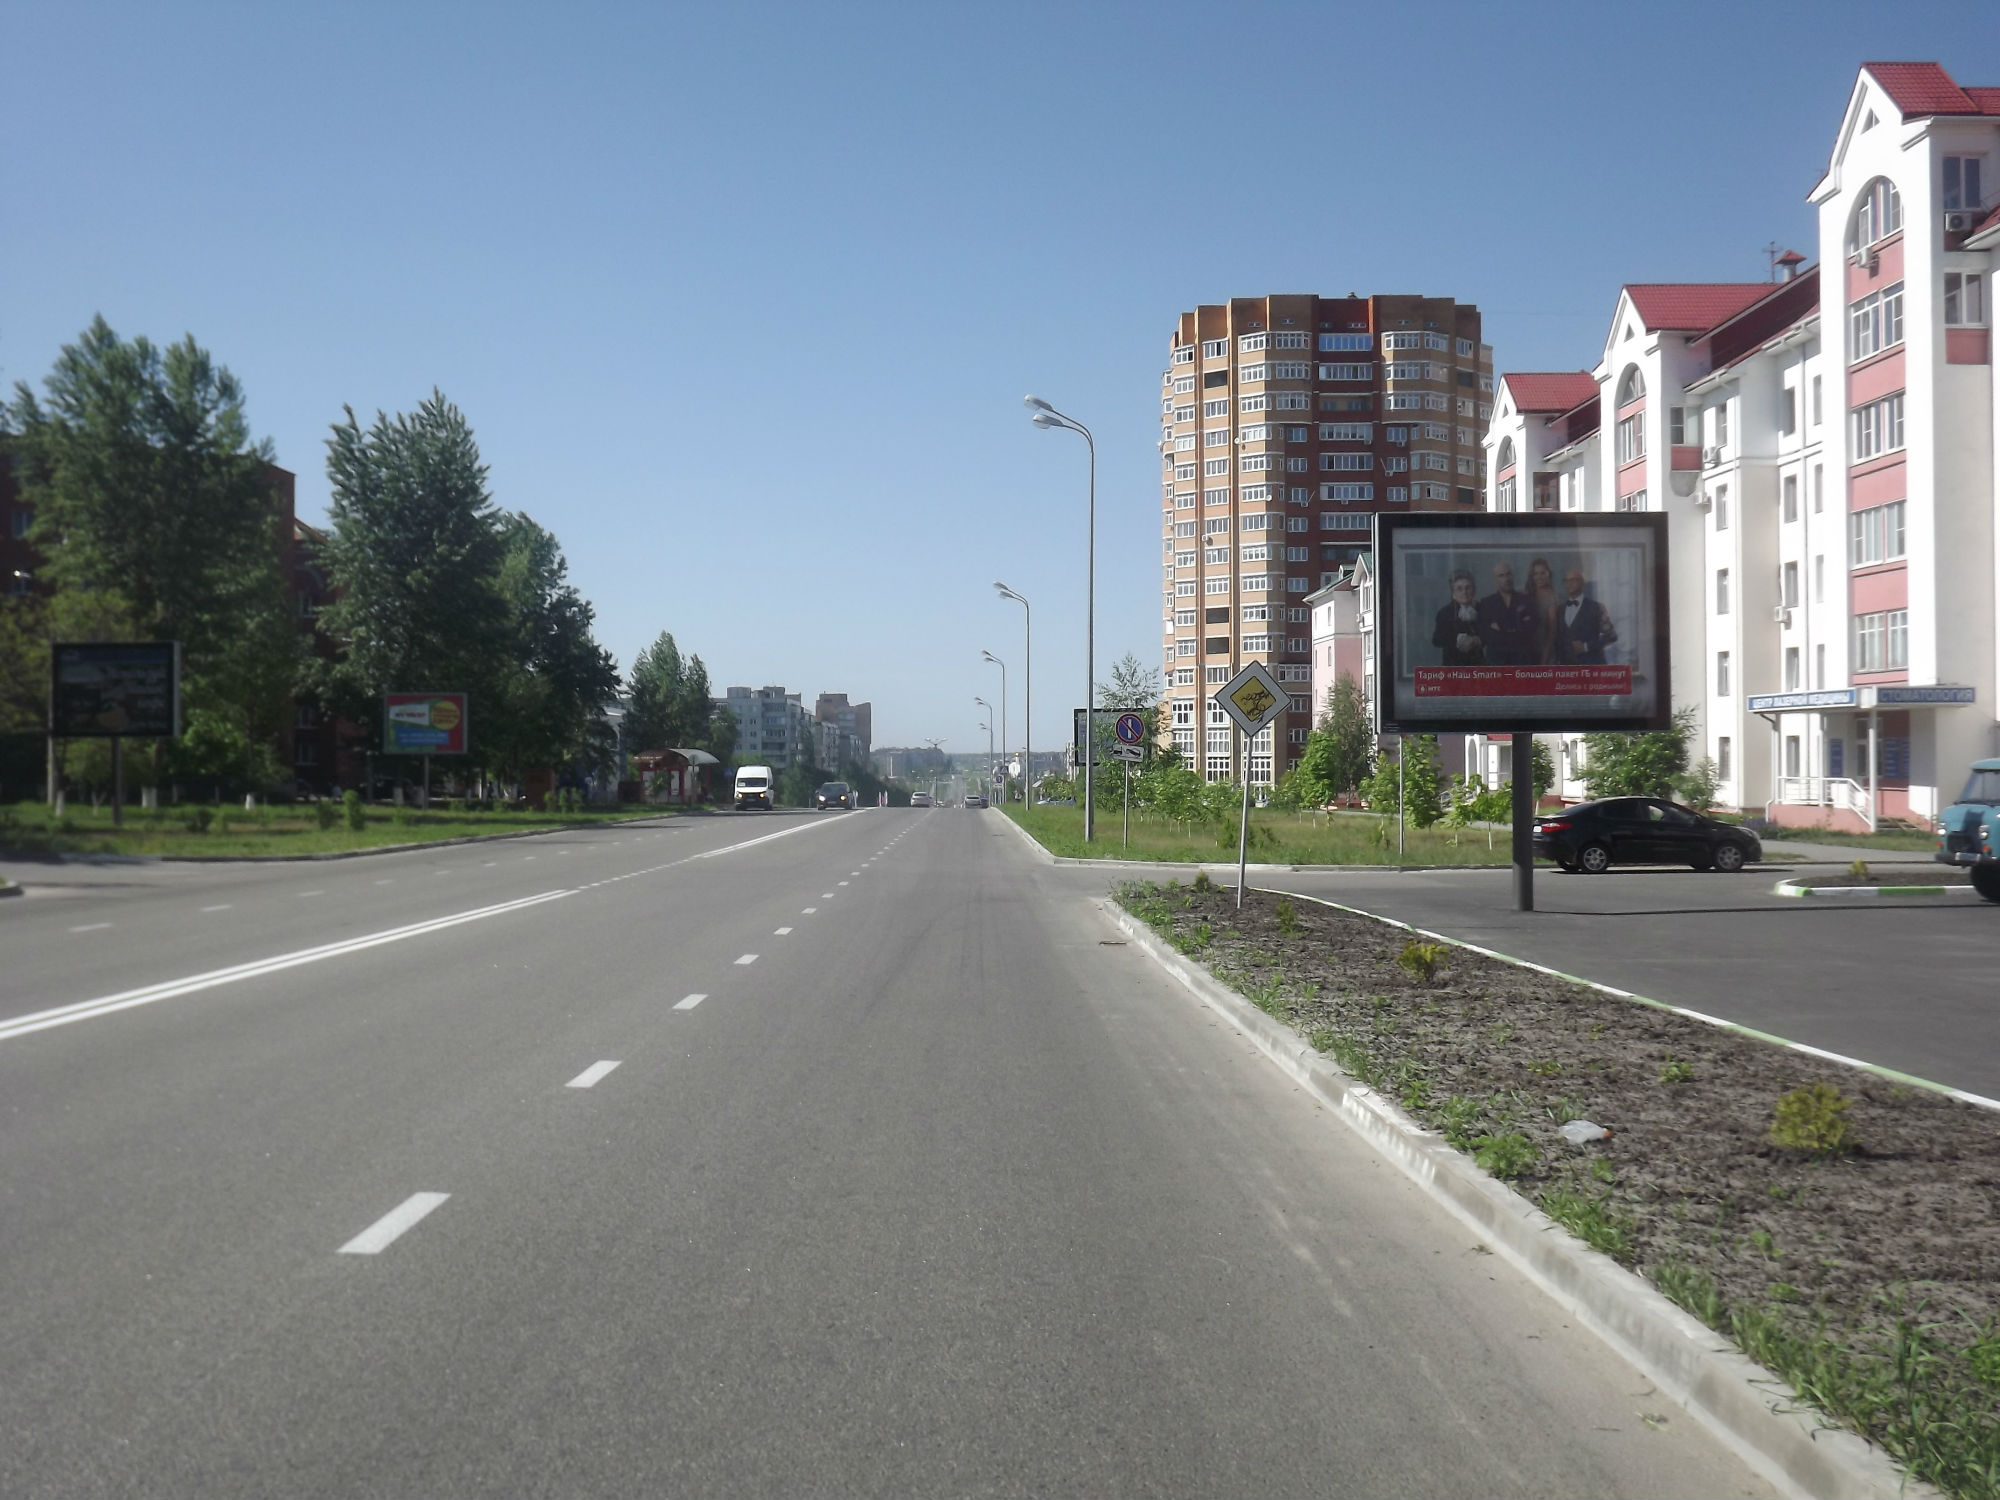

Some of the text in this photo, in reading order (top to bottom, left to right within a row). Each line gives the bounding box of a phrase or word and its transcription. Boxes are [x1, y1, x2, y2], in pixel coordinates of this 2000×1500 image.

[1418, 670, 1445, 680] Тариф
[1515, 669, 1553, 678] большой
[1555, 670, 1579, 678] пакет
[1581, 669, 1591, 678] ГБ
[1600, 670, 1627, 679] минут
[1880, 688, 1974, 703] СТОМАТОЛОГИЯ
[1752, 697, 1773, 709] ЦЕНТР
